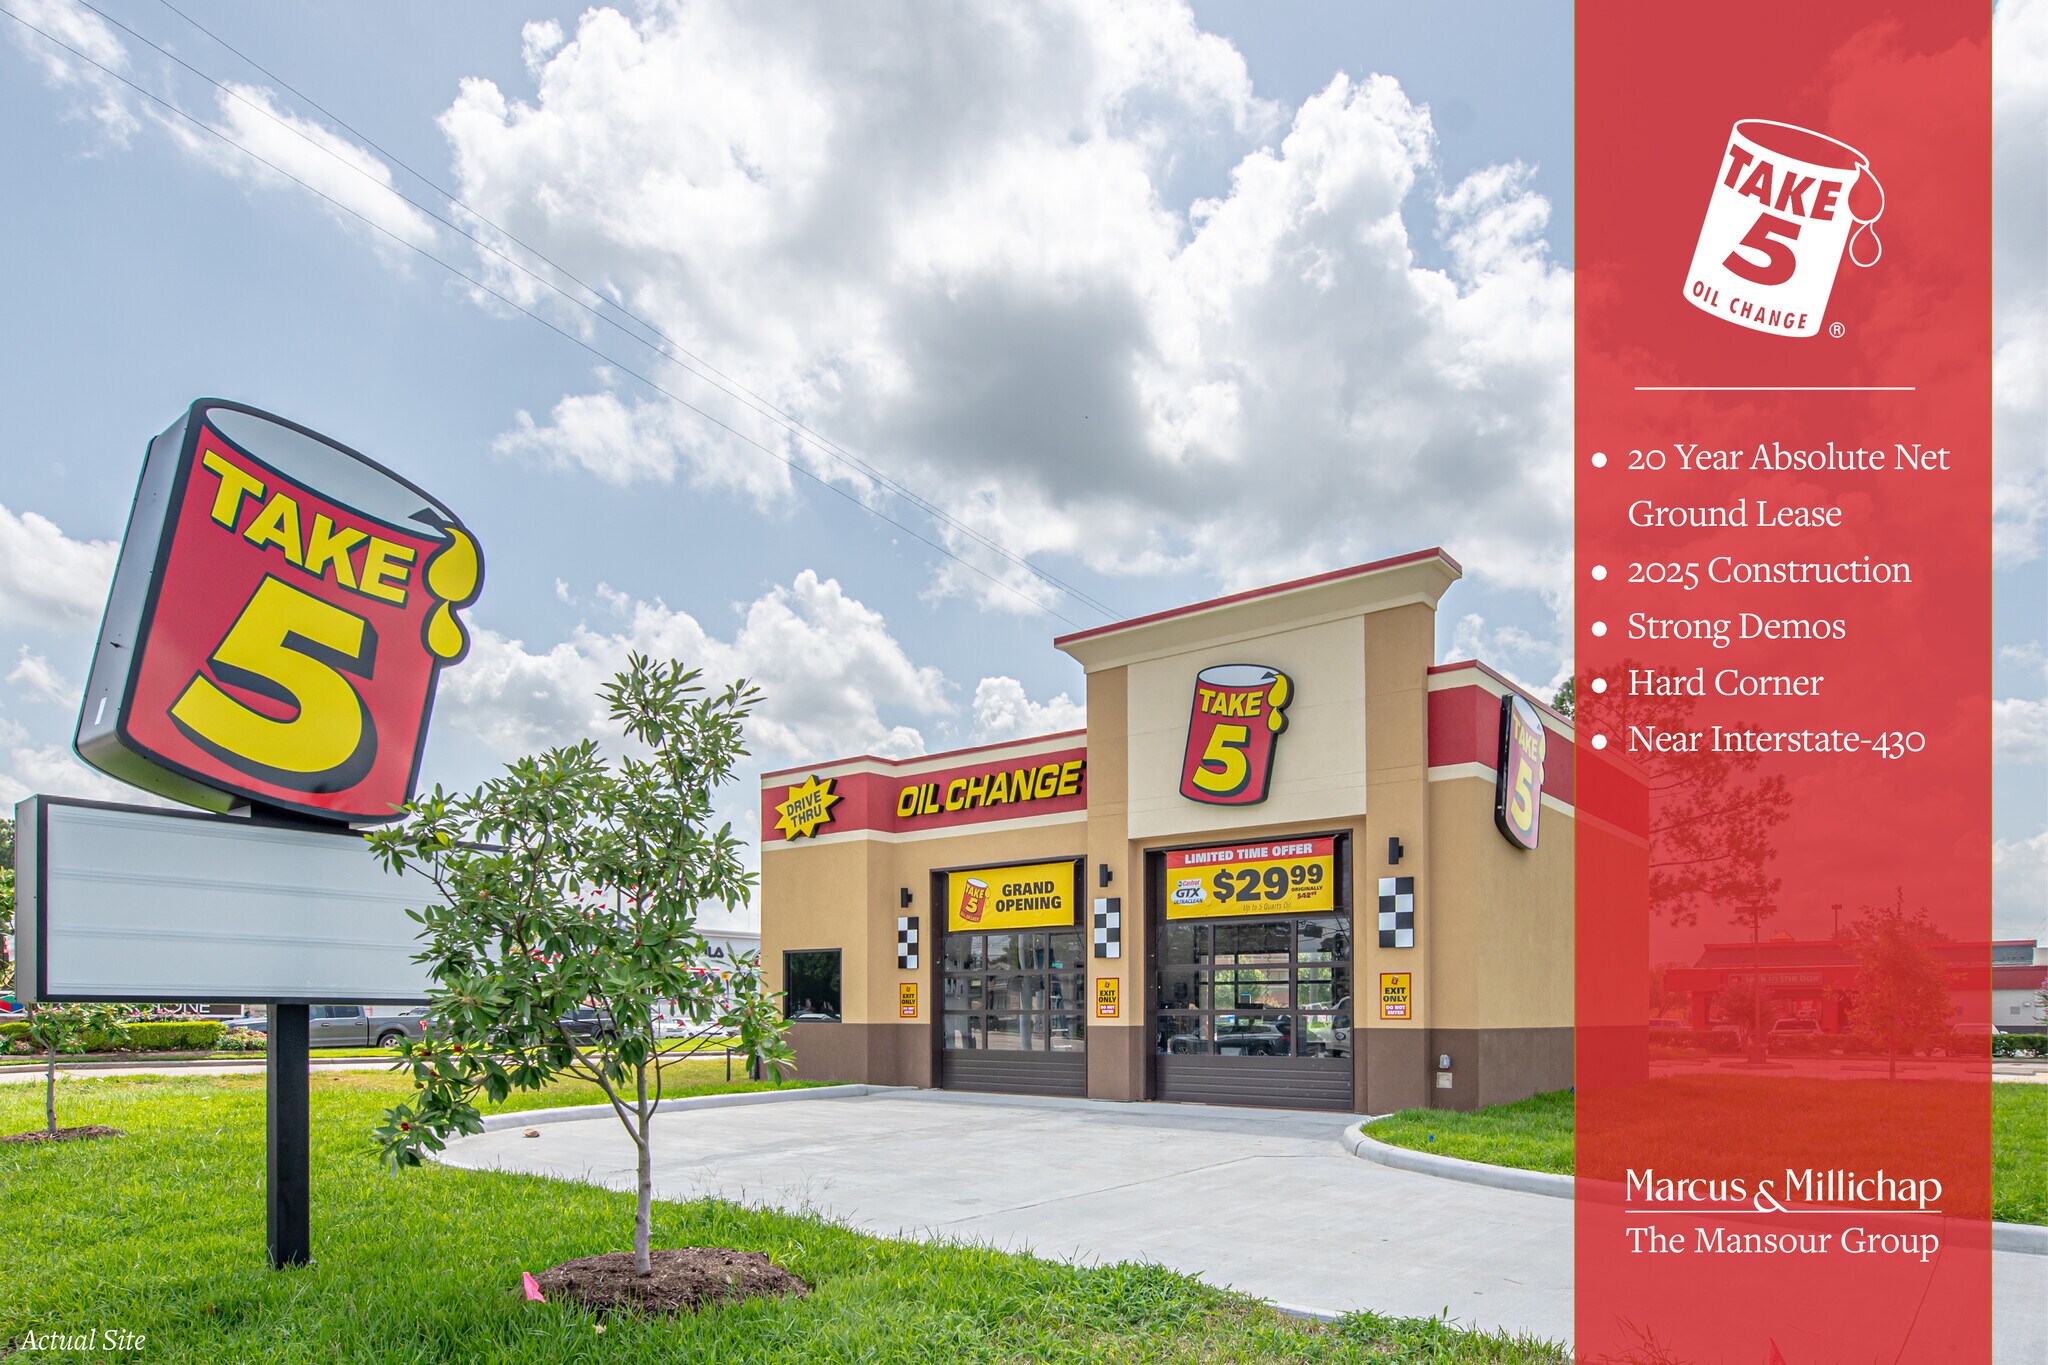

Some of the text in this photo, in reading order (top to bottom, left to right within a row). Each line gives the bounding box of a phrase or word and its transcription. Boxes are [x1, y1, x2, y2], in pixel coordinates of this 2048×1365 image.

[202, 448, 417, 607] TAKE
[168, 574, 376, 790] 5
[1199, 687, 1264, 718] TAKE
[1513, 713, 1538, 762] TAKE
[1191, 722, 1252, 796] 5
[786, 789, 822, 817] DRIVE
[897, 760, 1086, 818] OIL CHANGE
[1511, 757, 1534, 834] 5
[790, 804, 822, 828] THRU
[1184, 843, 1313, 864] LIMITED TIME OFFER
[965, 883, 985, 899] TAKE
[1002, 881, 1055, 897] GRAND
[1176, 888, 1200, 898] GTX
[965, 897, 979, 914] 5
[995, 896, 1062, 912] OPENING
